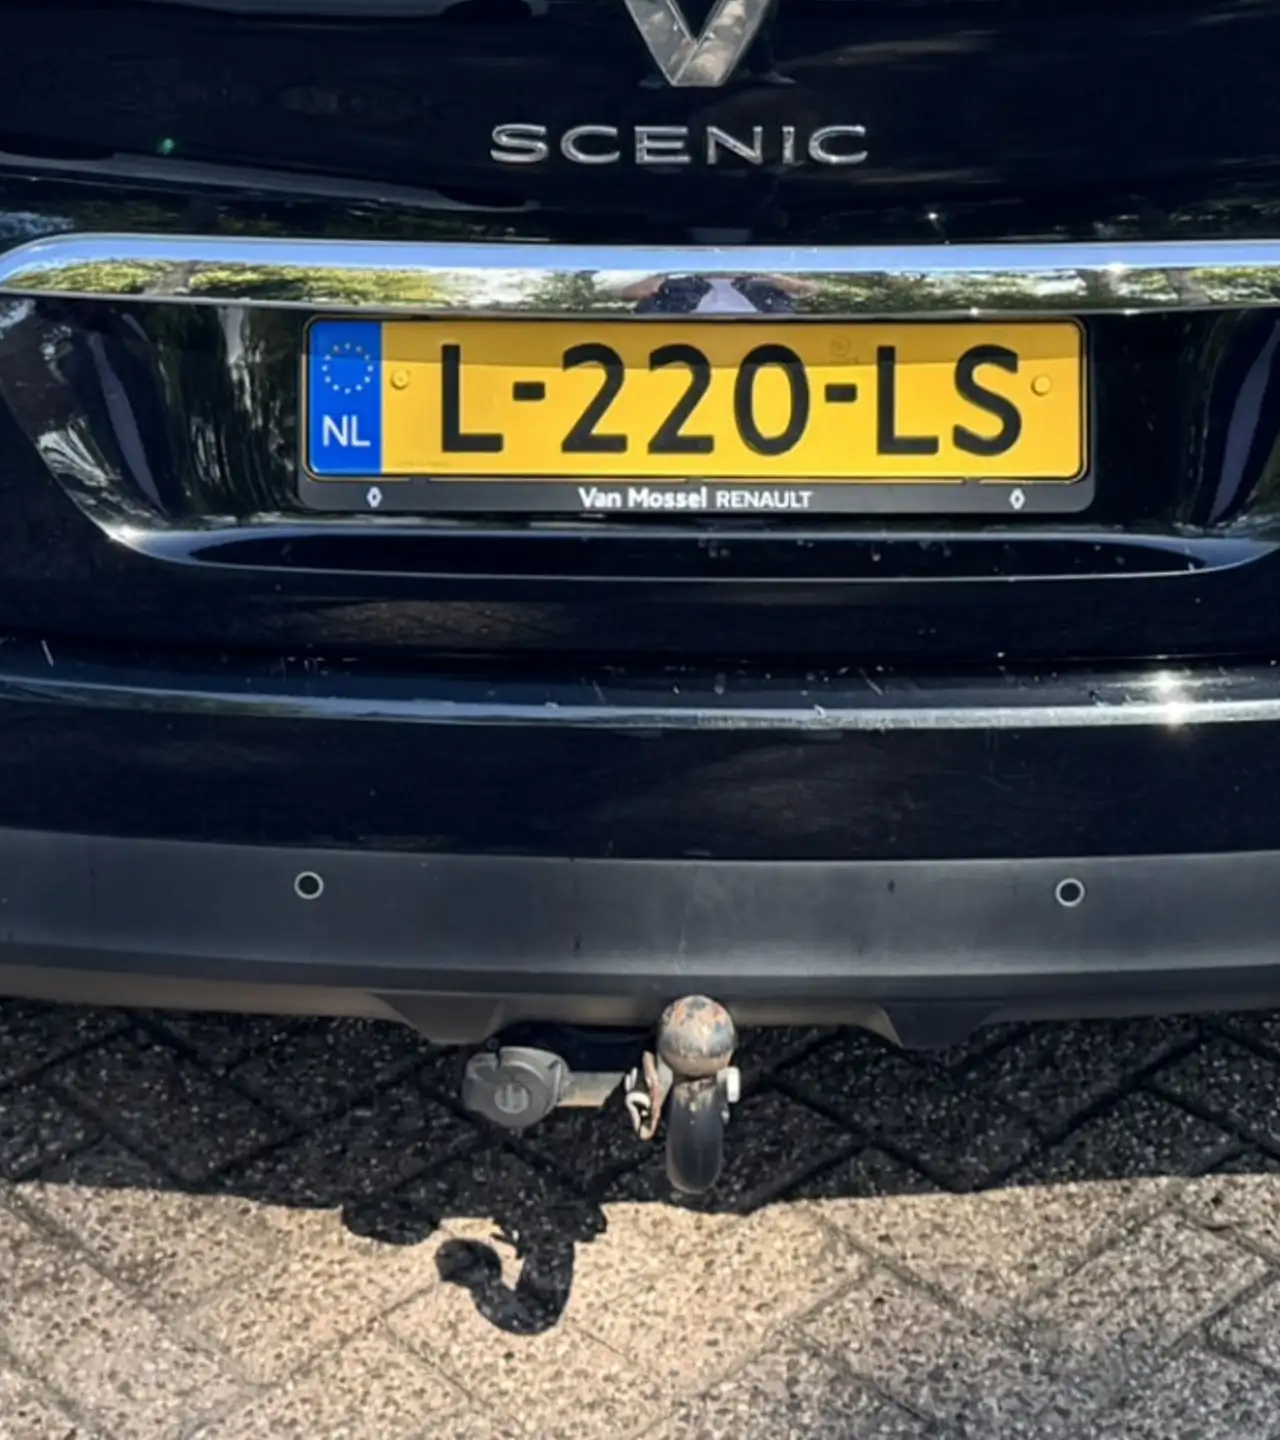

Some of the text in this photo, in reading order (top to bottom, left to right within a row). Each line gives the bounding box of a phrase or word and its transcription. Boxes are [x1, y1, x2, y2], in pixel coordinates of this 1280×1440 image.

[489, 122, 869, 165] SCENIC
[440, 342, 1023, 457] L-220-LS
[322, 414, 372, 448] NL
[577, 485, 813, 509] Van Mossel RENAULT
